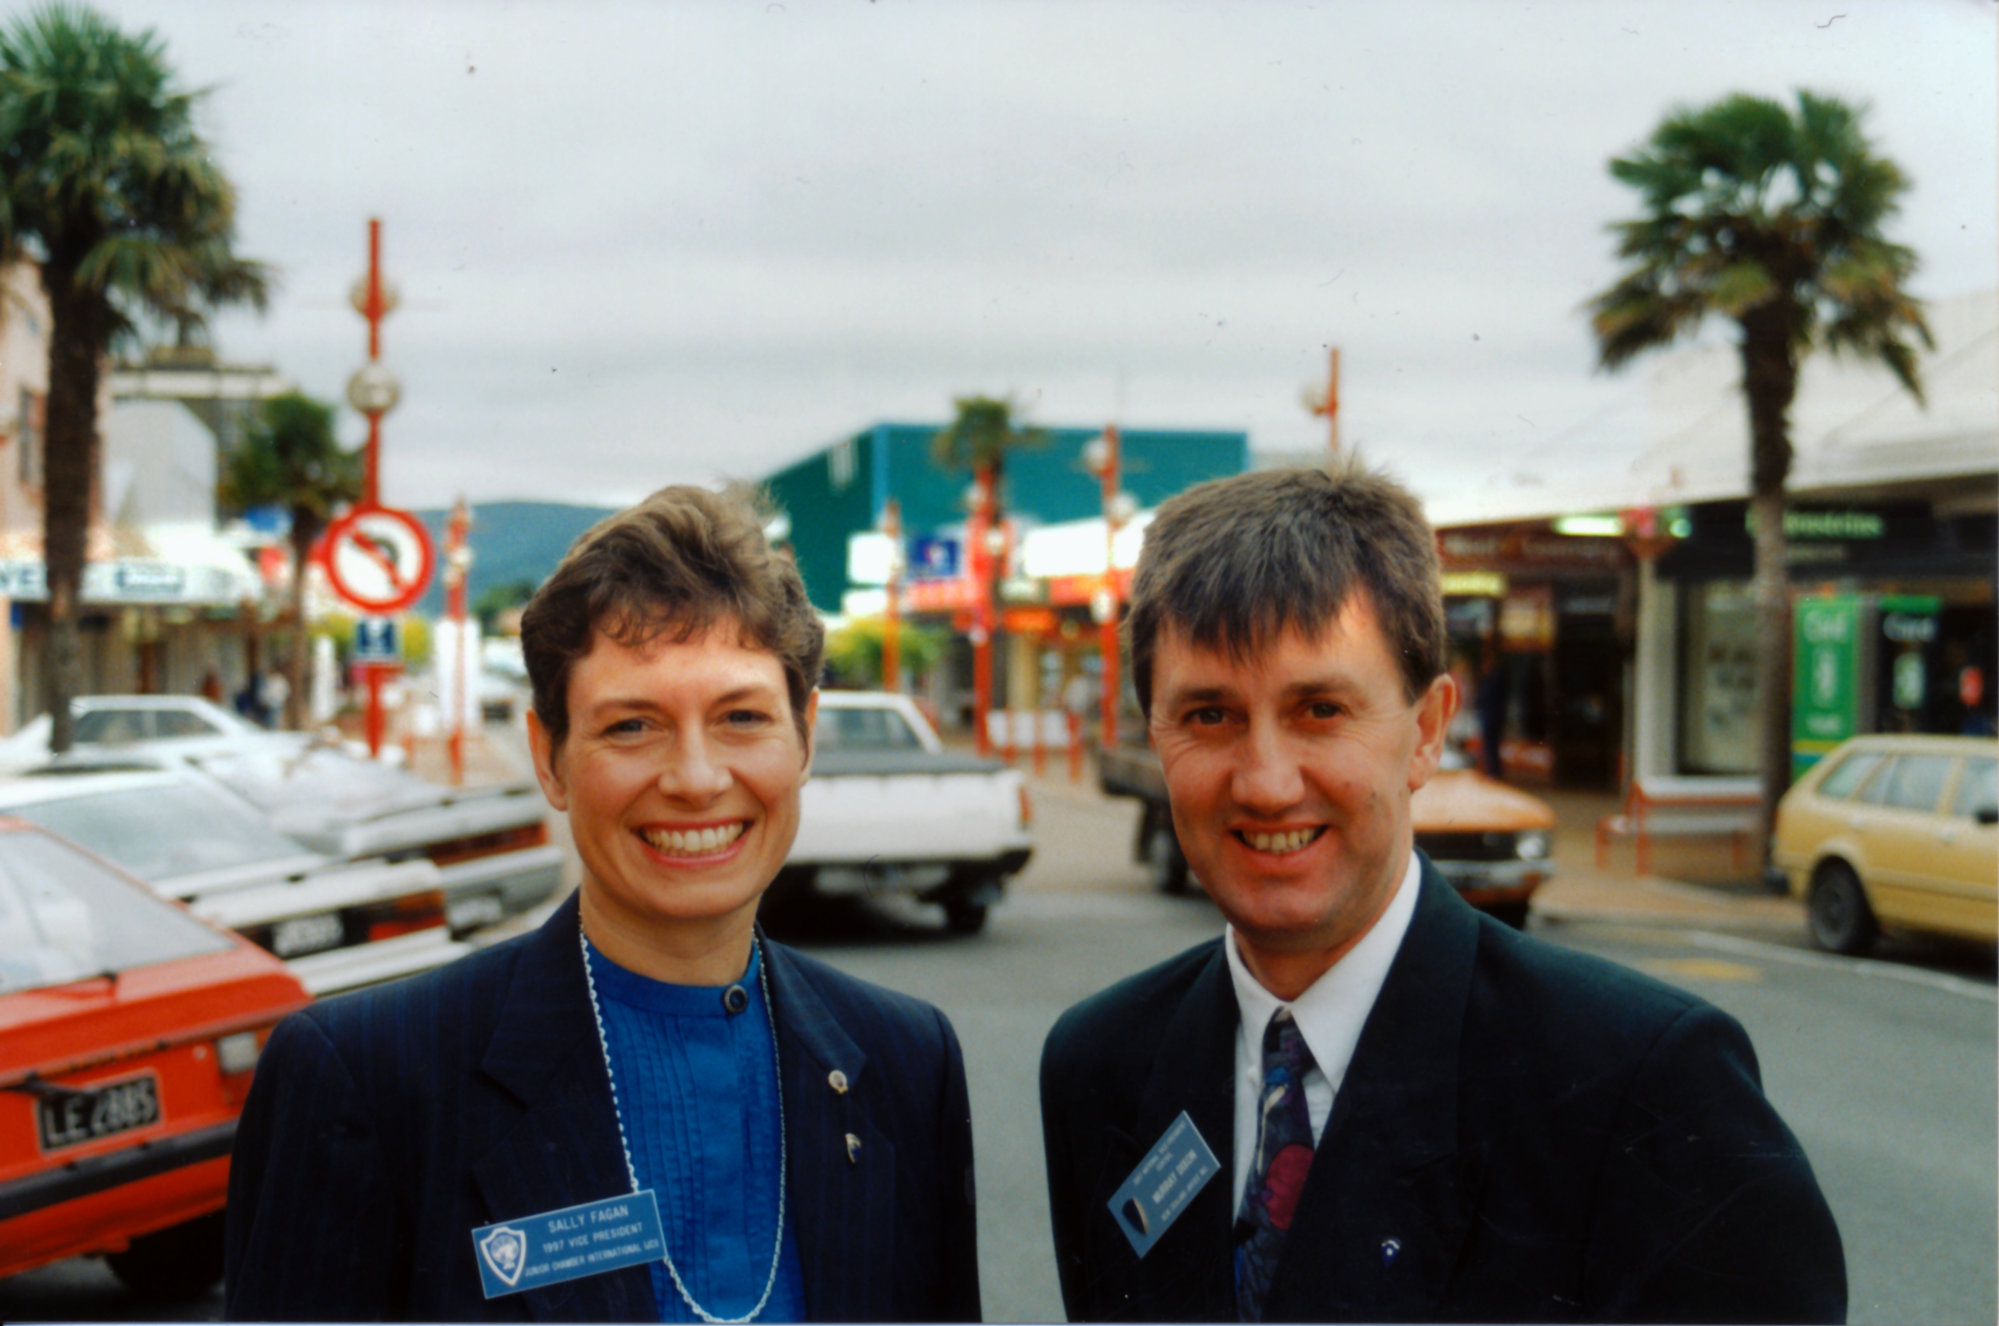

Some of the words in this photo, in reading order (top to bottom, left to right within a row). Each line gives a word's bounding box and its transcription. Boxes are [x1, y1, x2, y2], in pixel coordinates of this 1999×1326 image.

[548, 1214, 585, 1233] SALLY
[590, 1205, 629, 1223] FAGAN
[542, 1240, 564, 1253] 1997
[568, 1235, 589, 1248] VICE
[593, 1222, 642, 1242] PRESIDENT
[525, 1263, 550, 1277] JUNIOR
[551, 1256, 585, 1271] CHAMBER
[587, 1243, 641, 1263] INTERNATIONAL
